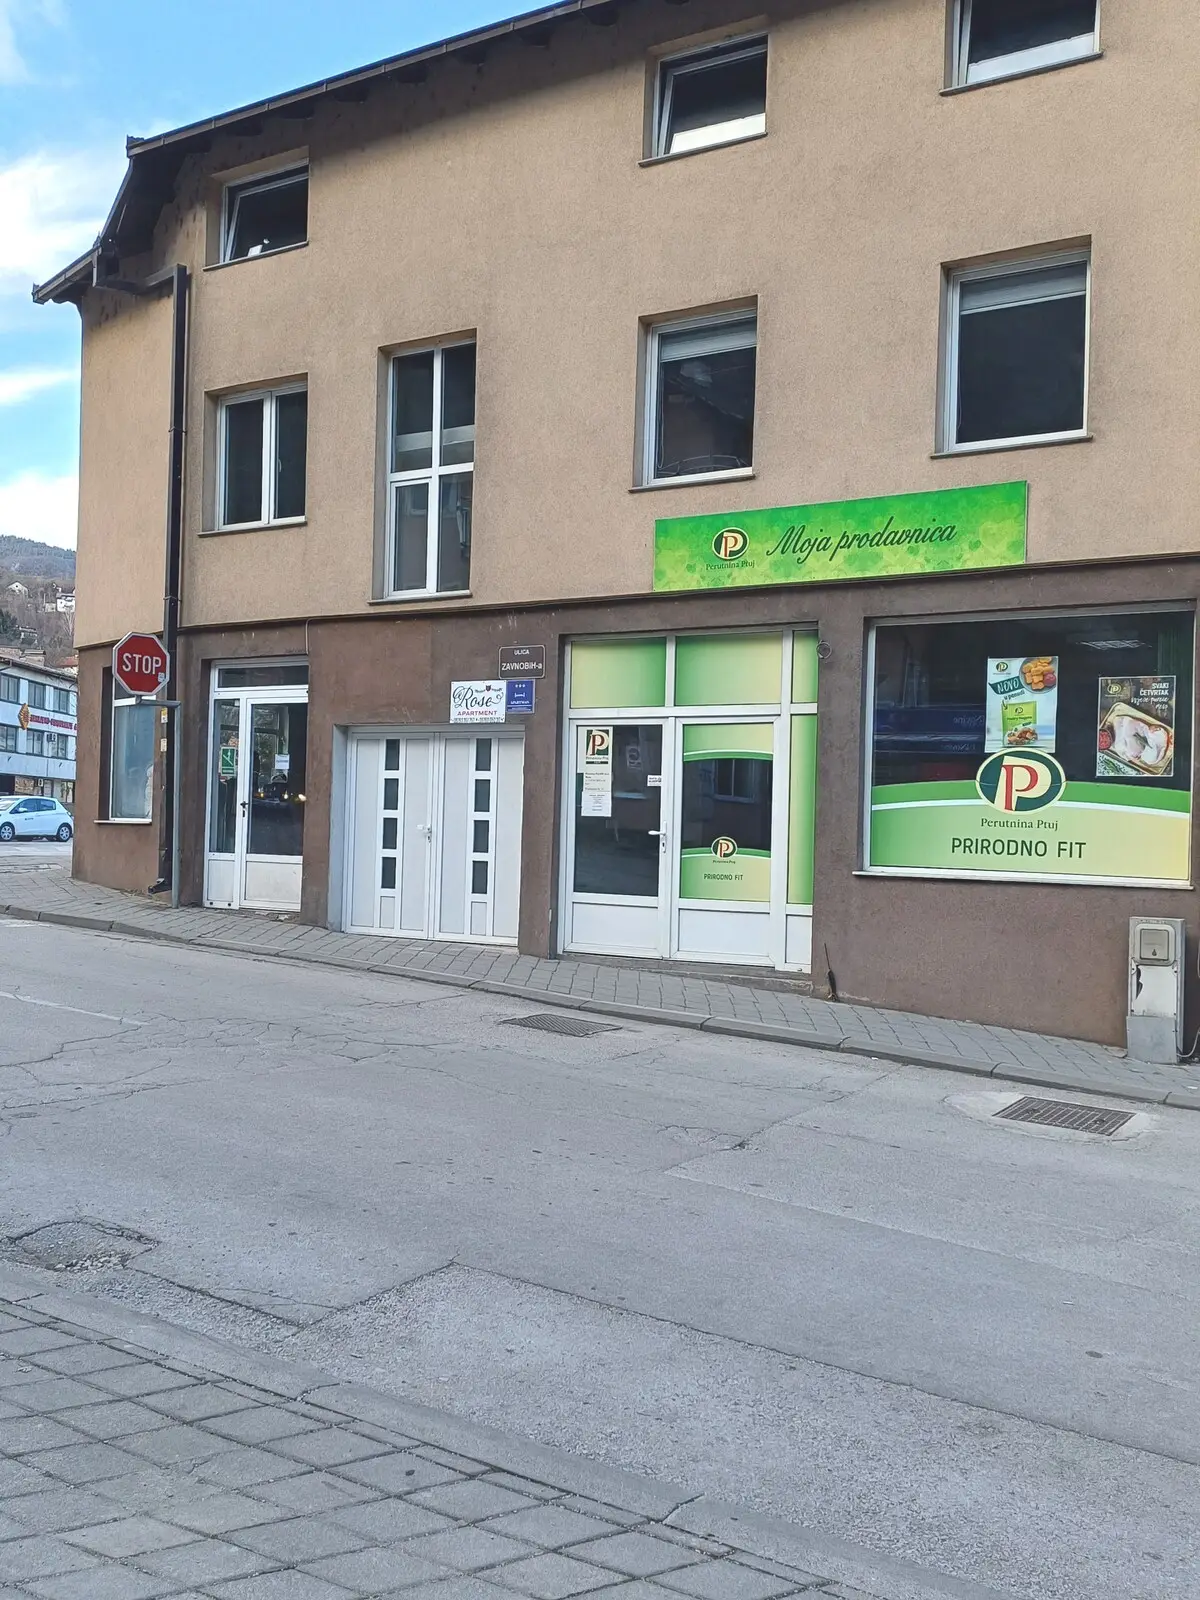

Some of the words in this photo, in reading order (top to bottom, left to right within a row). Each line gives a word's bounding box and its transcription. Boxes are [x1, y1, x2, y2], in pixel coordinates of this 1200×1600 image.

[766, 525, 833, 565] Moja
[829, 516, 957, 562] prodavnica
[706, 562, 740, 571] Perutnina
[741, 559, 755, 569] Ptuj
[122, 652, 162, 675] STOP
[997, 677, 1020, 694] NOVO
[1139, 688, 1169, 696] ČETVRTAK
[453, 685, 504, 711] Rose
[980, 818, 1034, 829] Perutnina
[1036, 819, 1059, 831] Ptuj
[951, 837, 1048, 857] PRIRODNO
[1057, 841, 1087, 859] FIT
[703, 873, 733, 881] PRIRODNO
